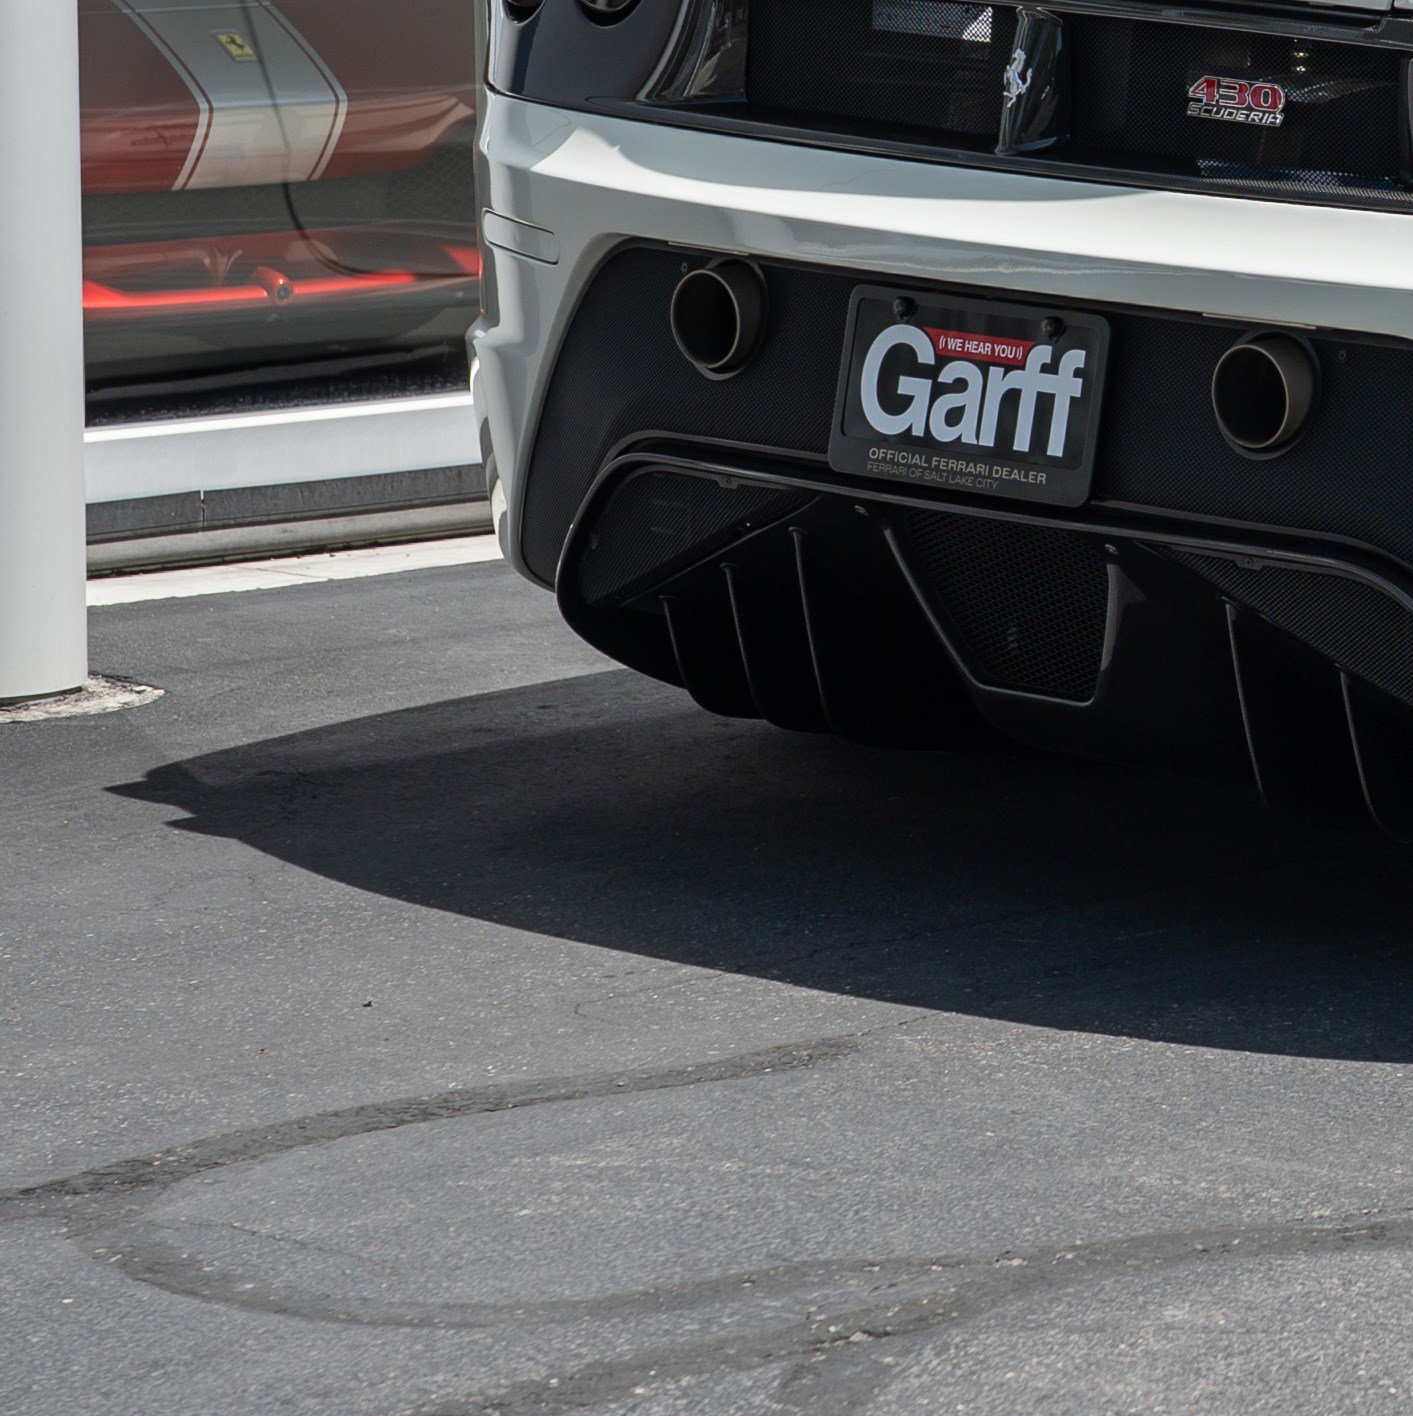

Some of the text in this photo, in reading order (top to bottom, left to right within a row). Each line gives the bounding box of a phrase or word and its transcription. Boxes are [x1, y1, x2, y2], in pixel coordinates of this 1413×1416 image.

[1188, 75, 1285, 113] 430
[1187, 102, 1285, 127] SCUDERIA
[946, 337, 1016, 359] WE HEAR YOU
[860, 323, 1086, 458] Garff
[866, 461, 999, 490] FERRARI OF SALT LAKE CITY
[868, 447, 1047, 485] OFFICIAL FERRARI DEALER
